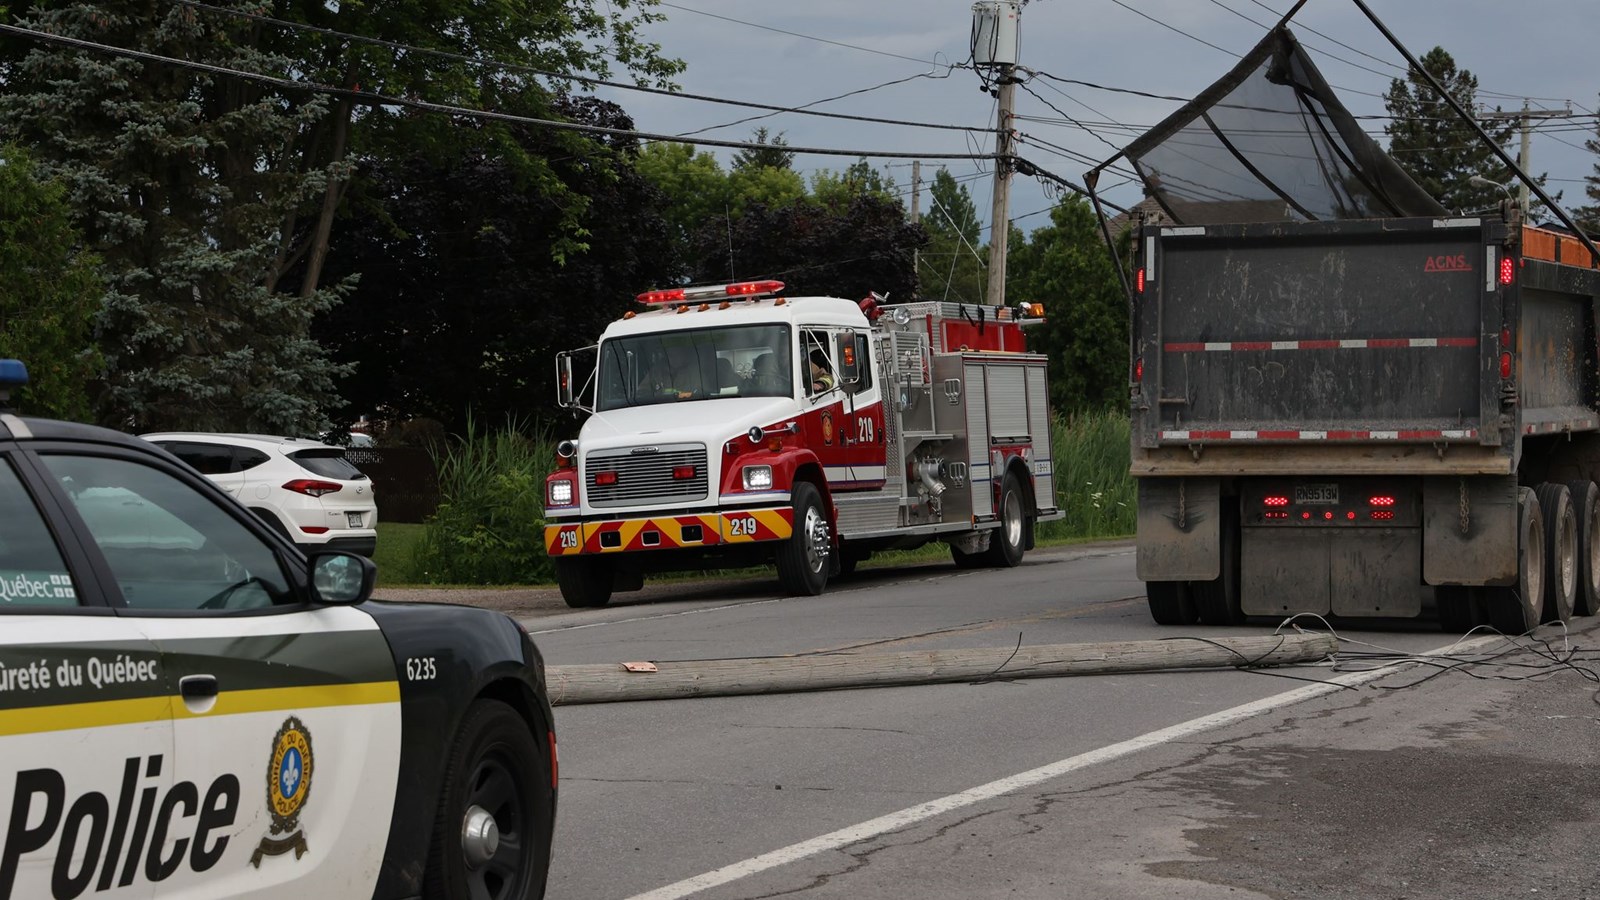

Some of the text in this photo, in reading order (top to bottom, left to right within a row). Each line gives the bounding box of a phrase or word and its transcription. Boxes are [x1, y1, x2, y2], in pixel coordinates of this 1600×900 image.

[858, 416, 874, 442] 219
[1296, 488, 1337, 500] RN9513W
[731, 517, 757, 536] 219
[560, 531, 578, 548] 219
[0, 654, 158, 691] ûreté du Québec
[406, 657, 437, 681] 6235
[287, 733, 297, 744] DU
[0, 754, 241, 900] Police
